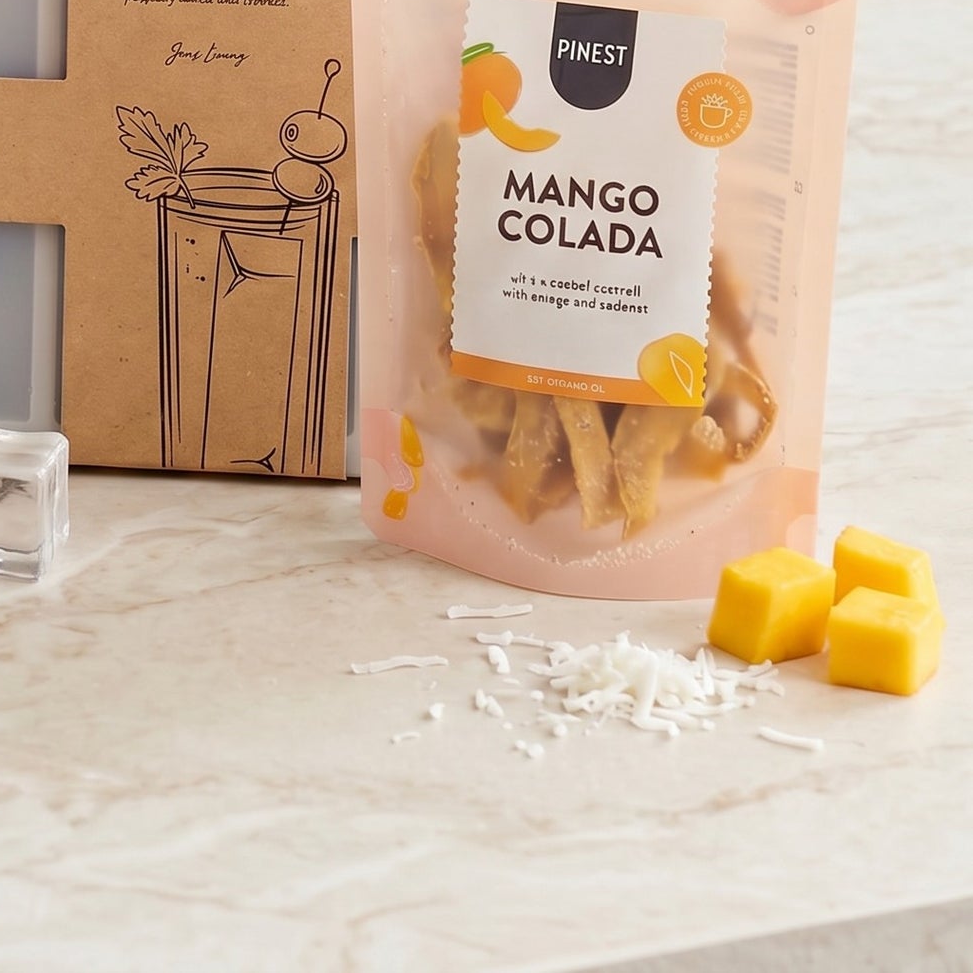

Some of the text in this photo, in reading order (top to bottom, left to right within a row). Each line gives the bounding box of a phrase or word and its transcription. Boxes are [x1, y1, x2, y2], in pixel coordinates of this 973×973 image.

[557, 39, 628, 67] PINEST
[503, 169, 660, 217] MANGO
[497, 209, 664, 259] COLADA
[503, 287, 528, 300] with
[573, 297, 596, 308] and
